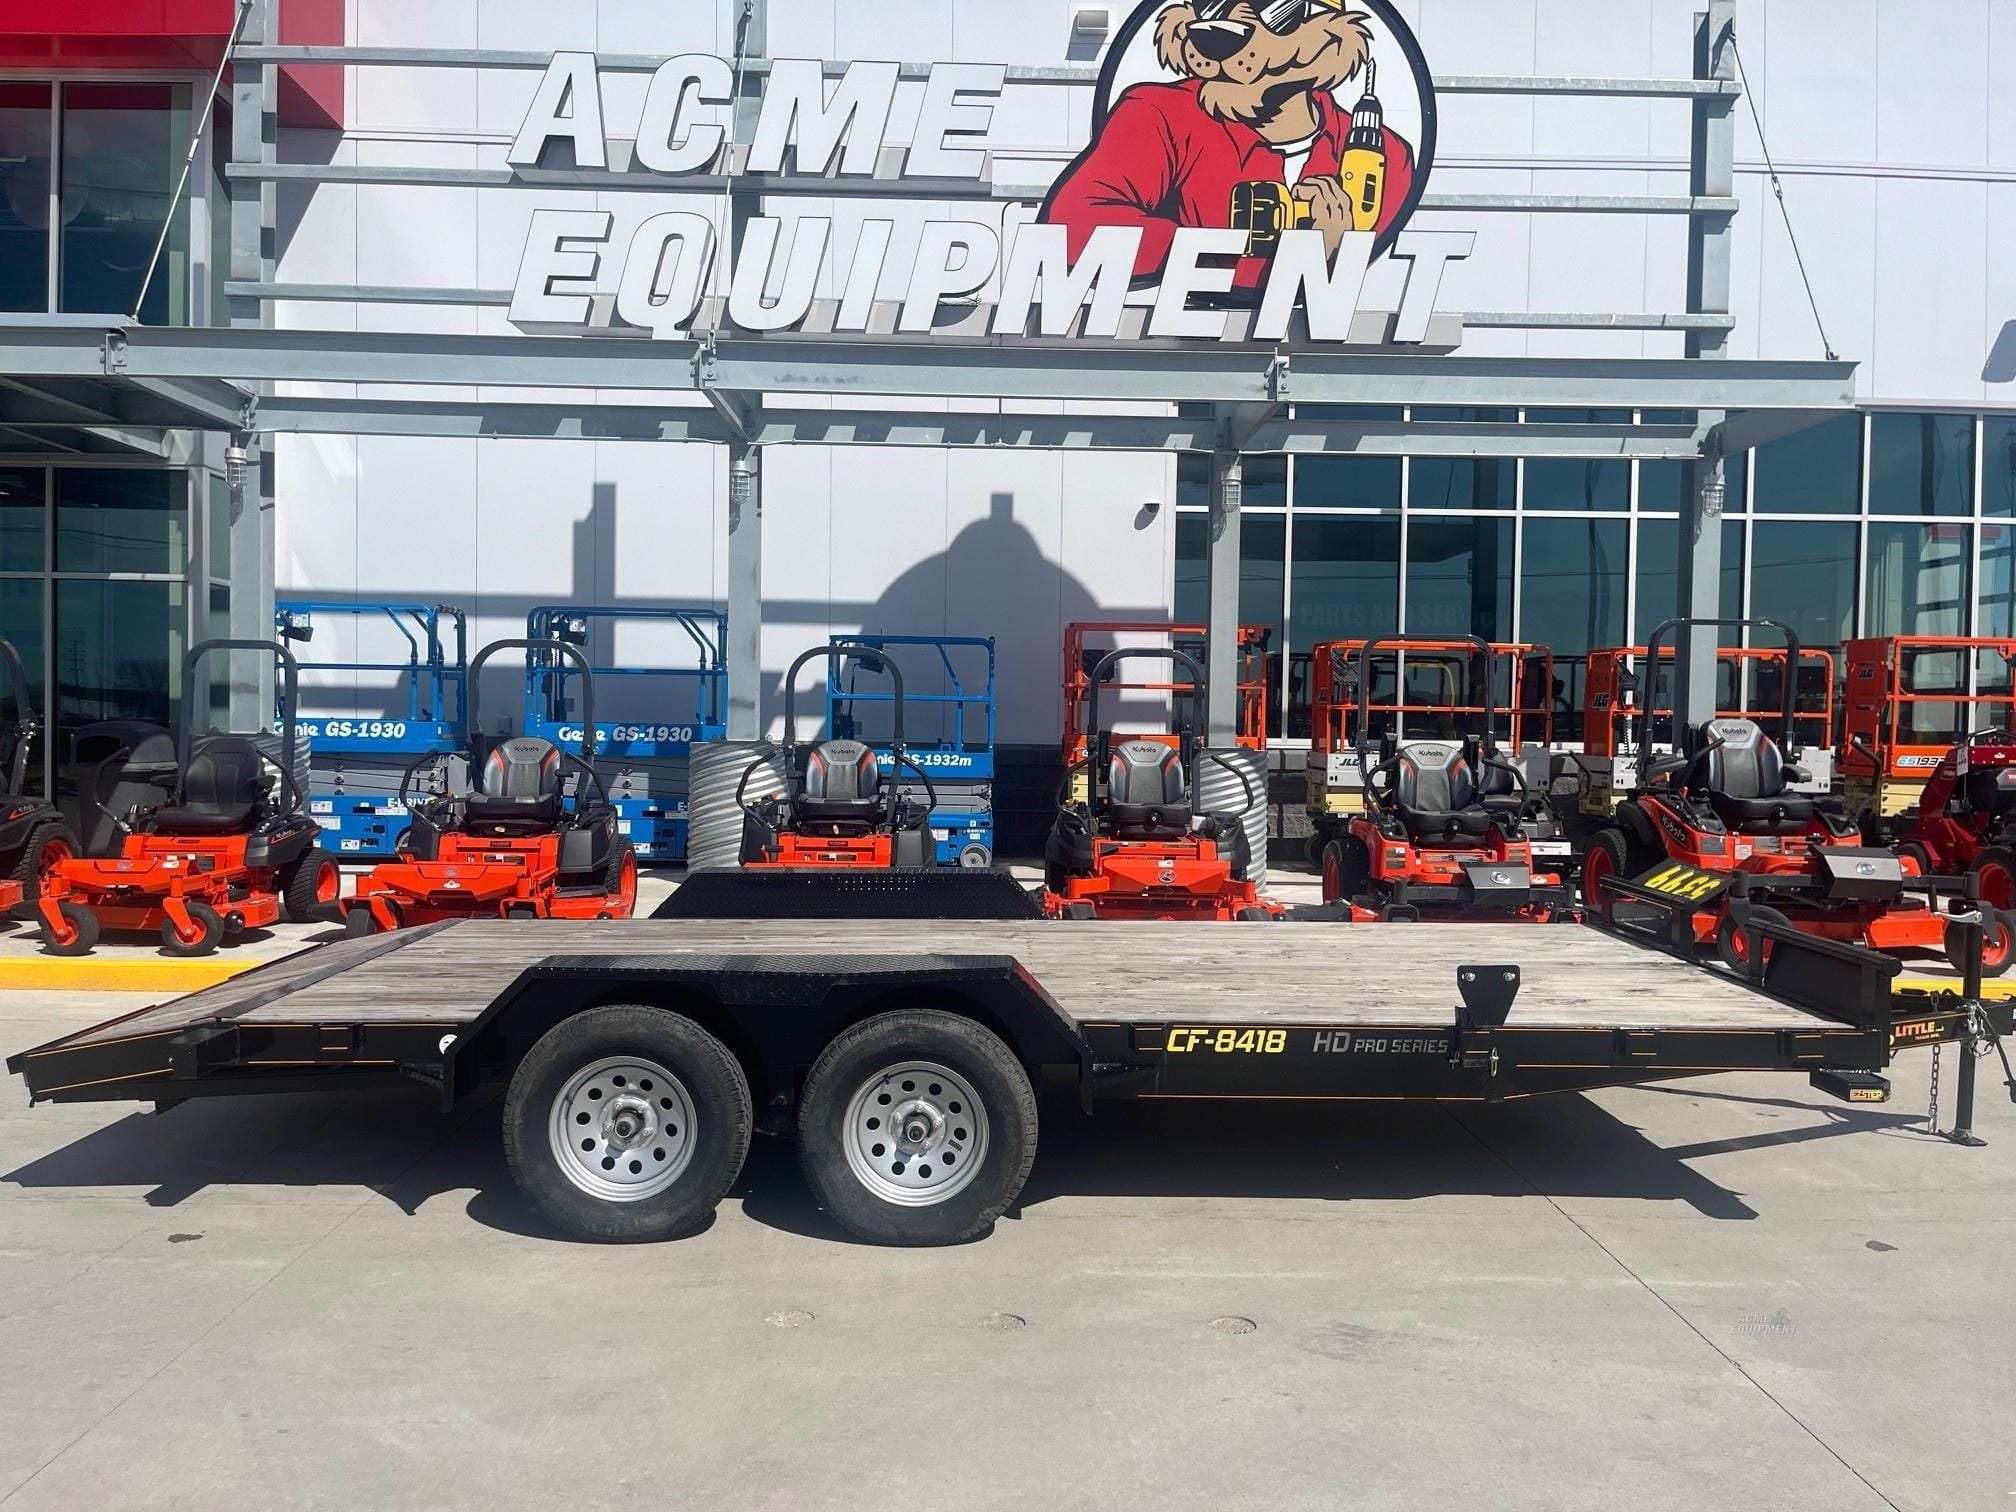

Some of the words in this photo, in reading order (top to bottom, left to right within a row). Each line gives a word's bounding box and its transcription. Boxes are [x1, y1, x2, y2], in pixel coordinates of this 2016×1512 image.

[507, 51, 1008, 178] ACME
[508, 209, 1477, 346] EQUIPMENT
[1592, 693, 1609, 708] JLG
[274, 723, 319, 737] Gnie
[326, 721, 406, 739] GS-1930
[558, 726, 606, 741] Gee
[612, 726, 693, 742] GS-1930
[1662, 814, 1686, 841] Kubota
[1895, 1021, 1935, 1037] LITTLE
[1167, 1029, 1287, 1053] CF-8418
[1313, 1031, 1351, 1053] HD
[1354, 1039, 1387, 1053] PRO
[1390, 1039, 1448, 1053] SERIES
